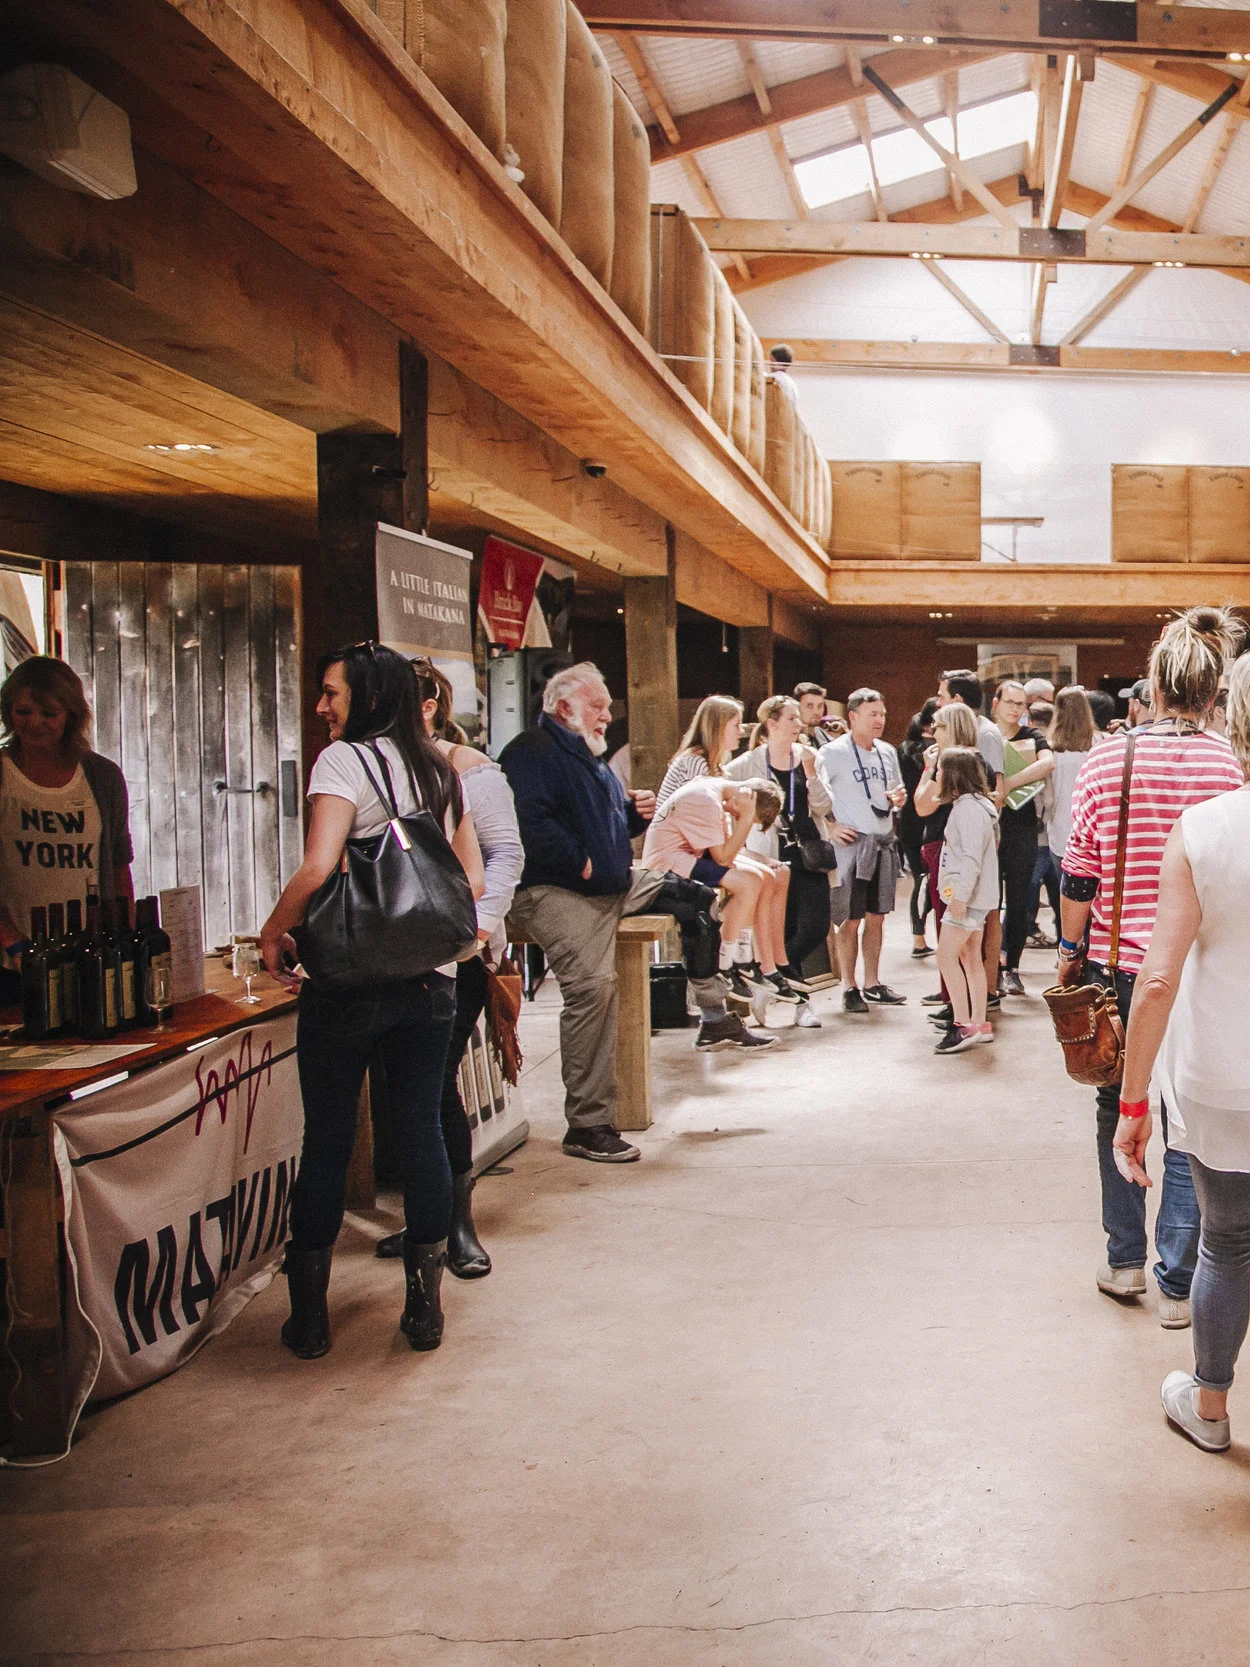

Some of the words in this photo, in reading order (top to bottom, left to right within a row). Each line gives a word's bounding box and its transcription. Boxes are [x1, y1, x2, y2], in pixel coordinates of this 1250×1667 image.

[390, 570, 398, 586] A
[400, 571, 430, 594] LITTLE
[432, 581, 469, 602] ITALIAN
[402, 597, 414, 615] IN
[21, 807, 85, 834] NEW
[14, 839, 94, 869] YORK
